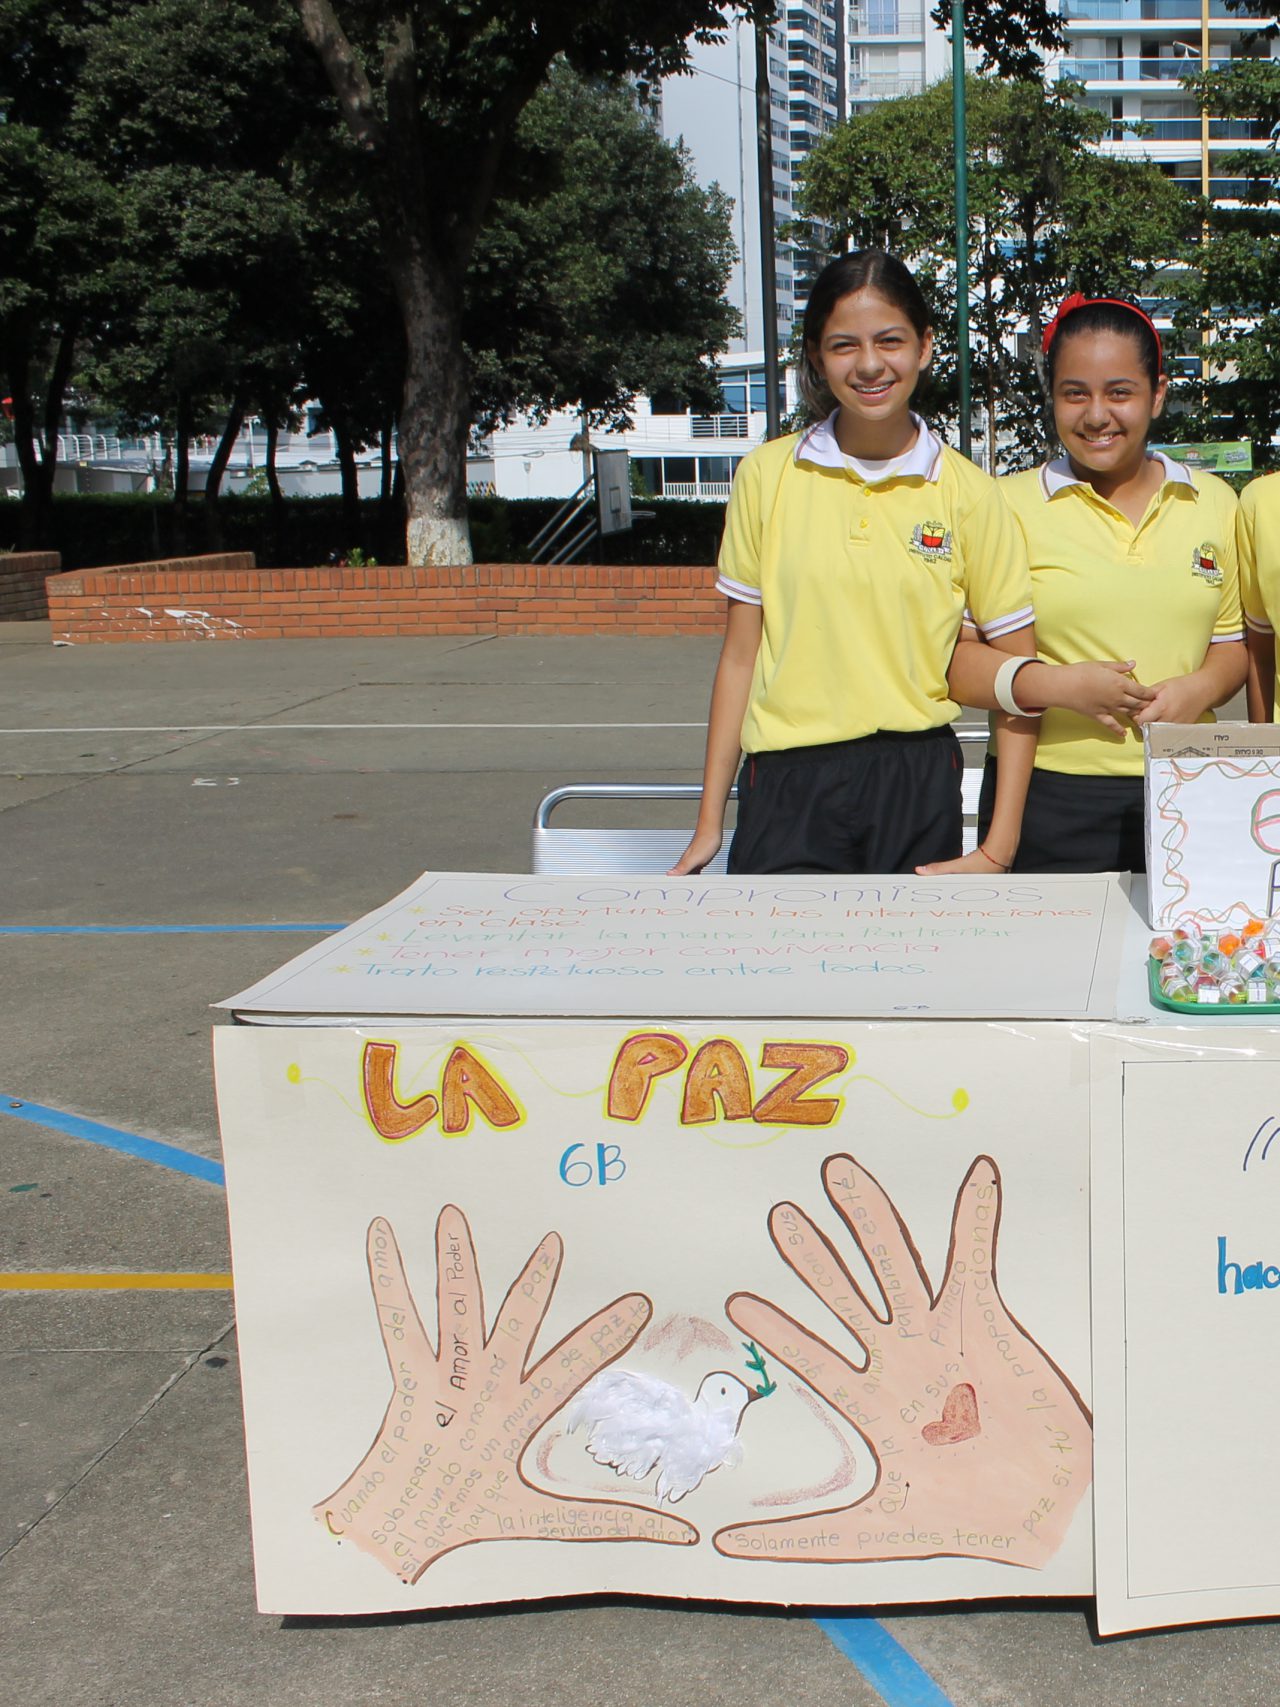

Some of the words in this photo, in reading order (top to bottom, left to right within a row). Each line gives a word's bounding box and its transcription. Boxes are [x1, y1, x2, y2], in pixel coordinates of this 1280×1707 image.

[1213, 734, 1230, 742] CALI
[503, 883, 1044, 906] Compromisos
[418, 917, 464, 928] en
[438, 905, 502, 917] Ser
[706, 908, 755, 919] en
[769, 905, 824, 919] las
[388, 945, 500, 961] Tener
[523, 946, 664, 962] mejor
[677, 942, 941, 959] convivencia
[402, 929, 578, 942] Levantar
[597, 929, 629, 941] la
[645, 929, 753, 941] mano
[359, 962, 459, 977] Trato
[684, 961, 797, 977] entre
[363, 1040, 525, 1141] LA
[604, 1032, 854, 1130] PAZ
[558, 1142, 627, 1187] 6B
[779, 1209, 805, 1247] sus
[372, 1219, 395, 1289] amor
[801, 1249, 835, 1288] con
[452, 1291, 468, 1317] al
[378, 1302, 407, 1342] del
[832, 1385, 881, 1427] paz
[899, 1398, 926, 1425] en
[924, 1362, 961, 1400] sus
[1025, 1388, 1058, 1414] la
[423, 1469, 483, 1549] queremos
[480, 1437, 502, 1463] un
[502, 1376, 554, 1433] mundo
[559, 1345, 583, 1370] de
[589, 1311, 627, 1346] paz
[434, 1400, 458, 1428] el
[393, 1531, 417, 1558] el
[413, 1461, 463, 1530] mundo
[498, 1315, 524, 1342] la
[880, 1434, 905, 1458] la
[458, 1501, 498, 1538] hay
[482, 1469, 510, 1501] que
[1021, 1496, 1057, 1539] paz
[856, 1525, 945, 1549] puedes
[951, 1529, 1018, 1550] tener
